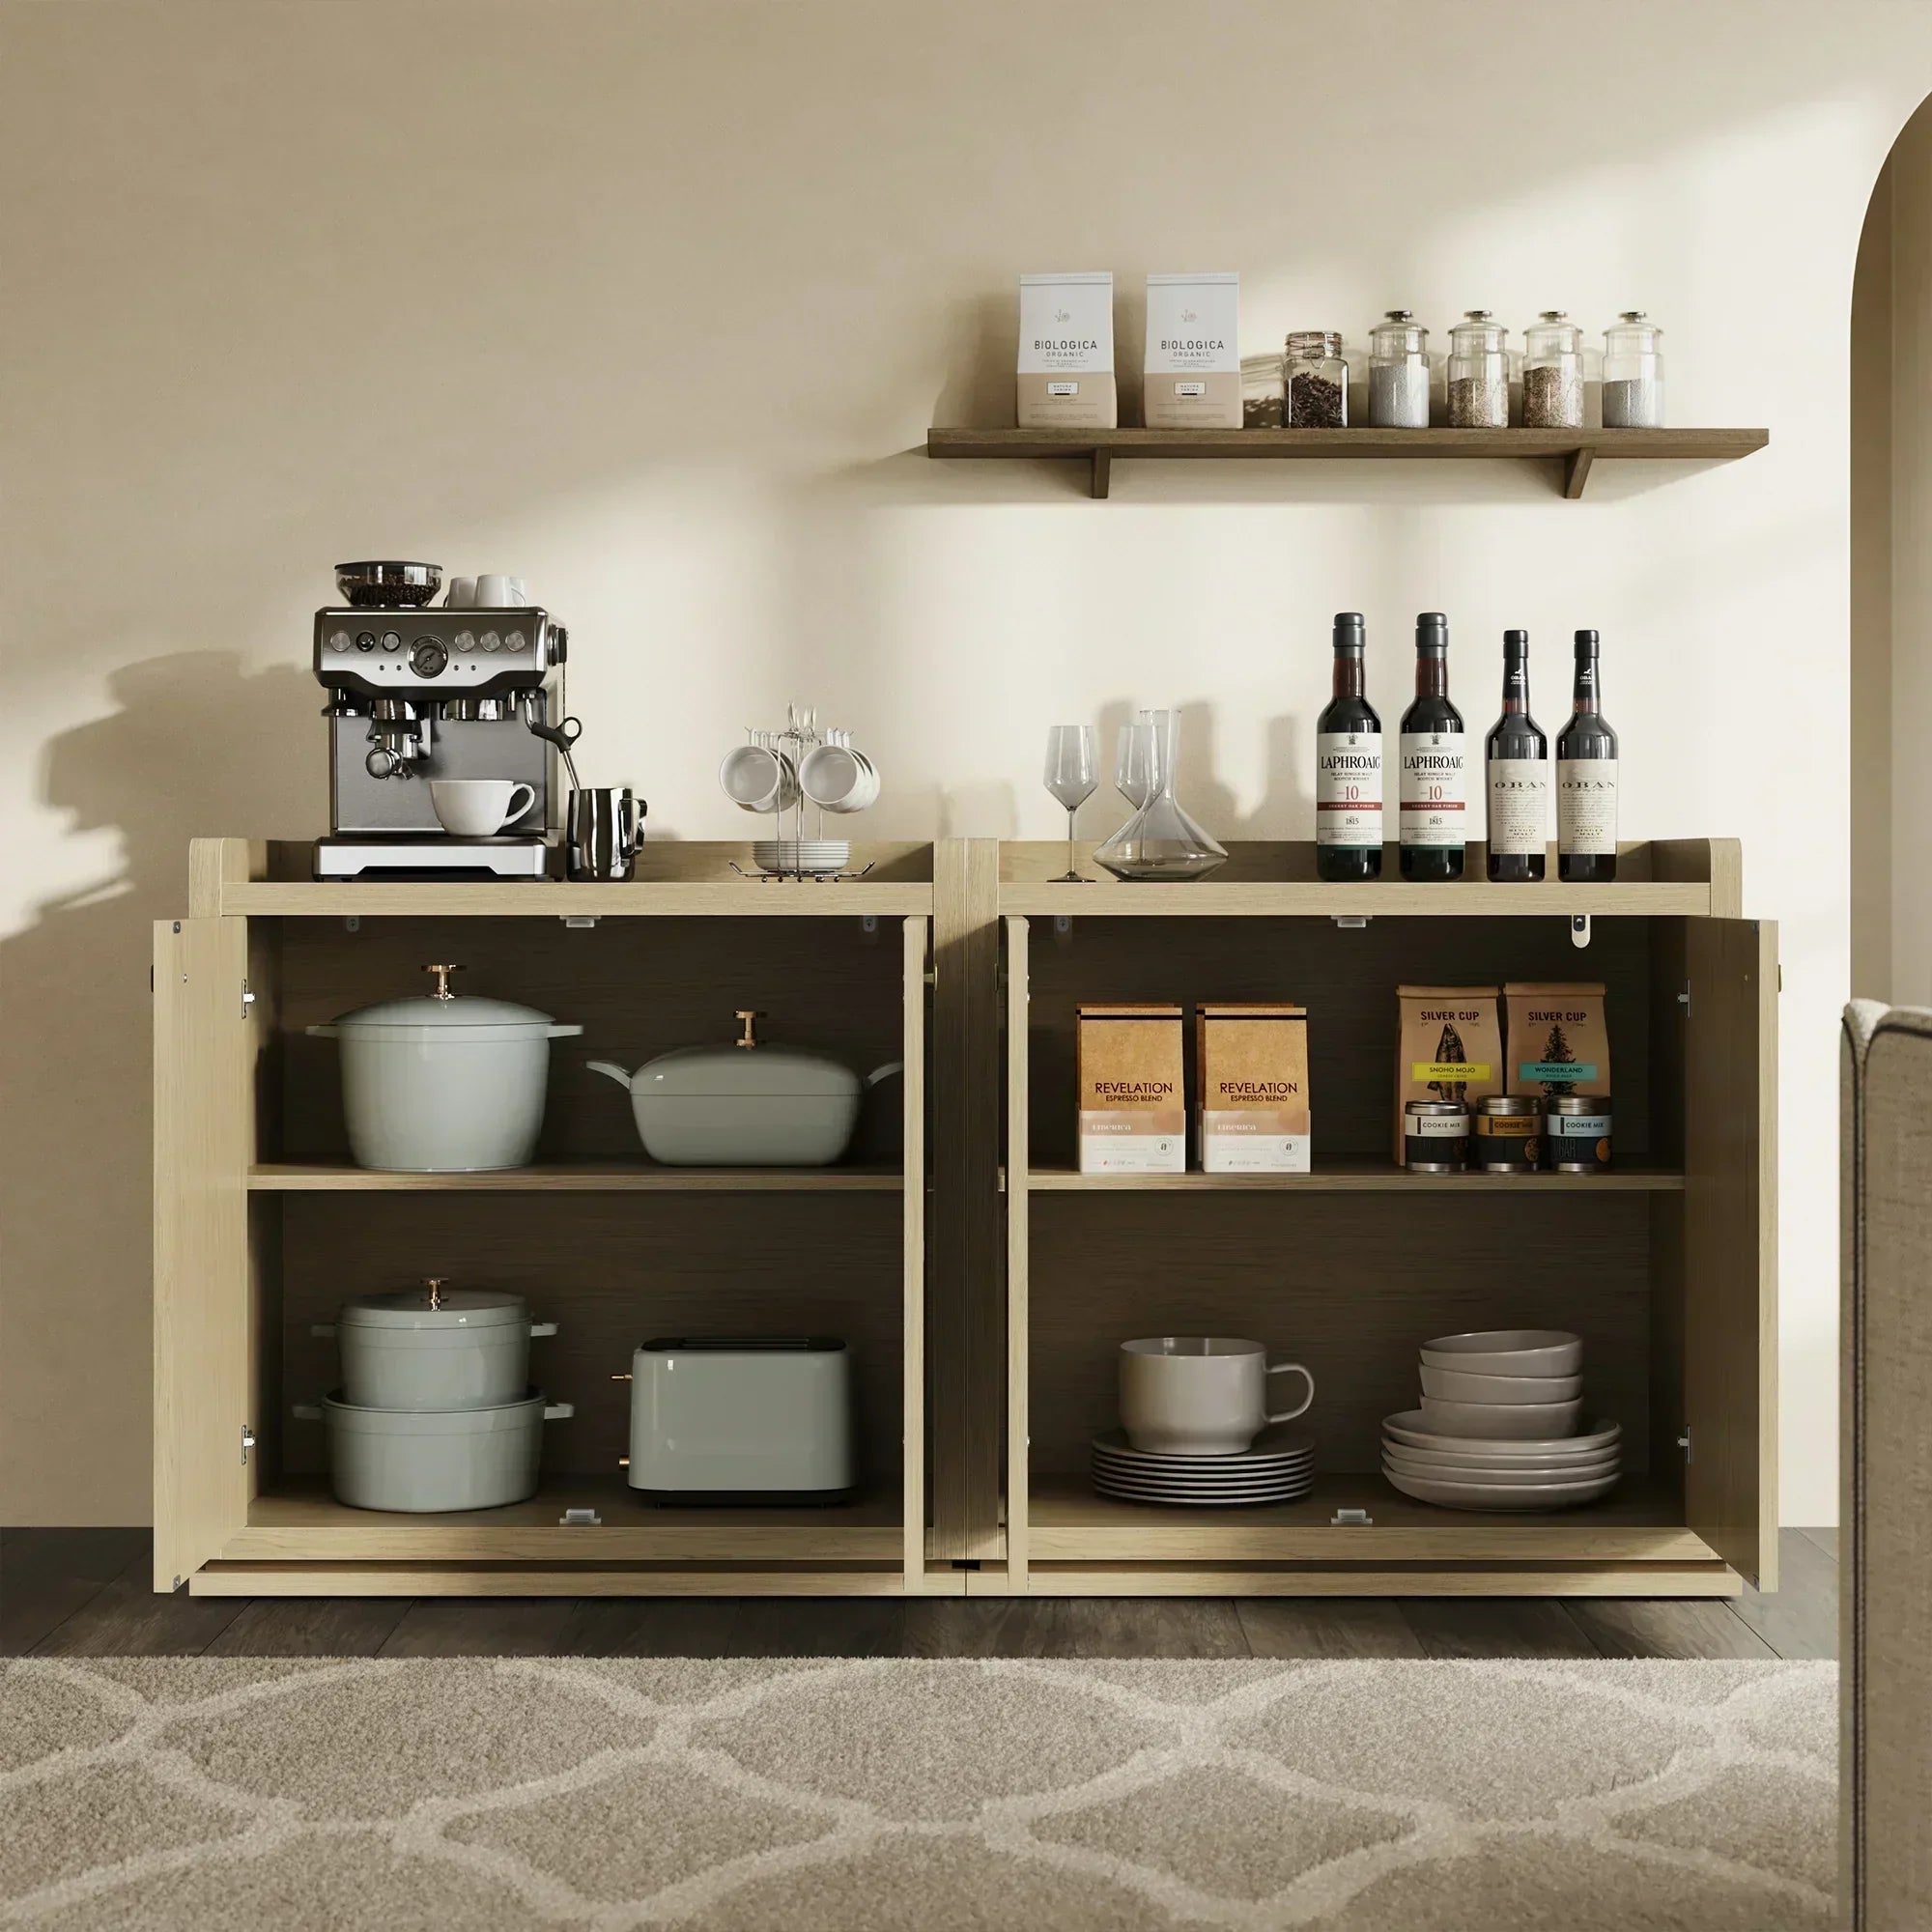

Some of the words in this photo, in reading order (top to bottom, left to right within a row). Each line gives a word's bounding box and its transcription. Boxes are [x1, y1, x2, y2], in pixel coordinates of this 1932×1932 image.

[1035, 340, 1097, 350] BIOLOGICA
[1161, 340, 1225, 350] BIOLOGICA
[1321, 755, 1380, 769] LAPHROAIG
[1404, 755, 1463, 769] LAPHROAIG
[1346, 784, 1359, 800] 10
[1429, 784, 1442, 800] 10
[1421, 1011, 1456, 1020] SILVER
[1459, 1011, 1479, 1020] CUP
[1528, 1011, 1563, 1021] SILVER
[1566, 1011, 1587, 1021] CUP
[1095, 1083, 1173, 1094] REVELATION
[1220, 1083, 1297, 1094] REVELATION
